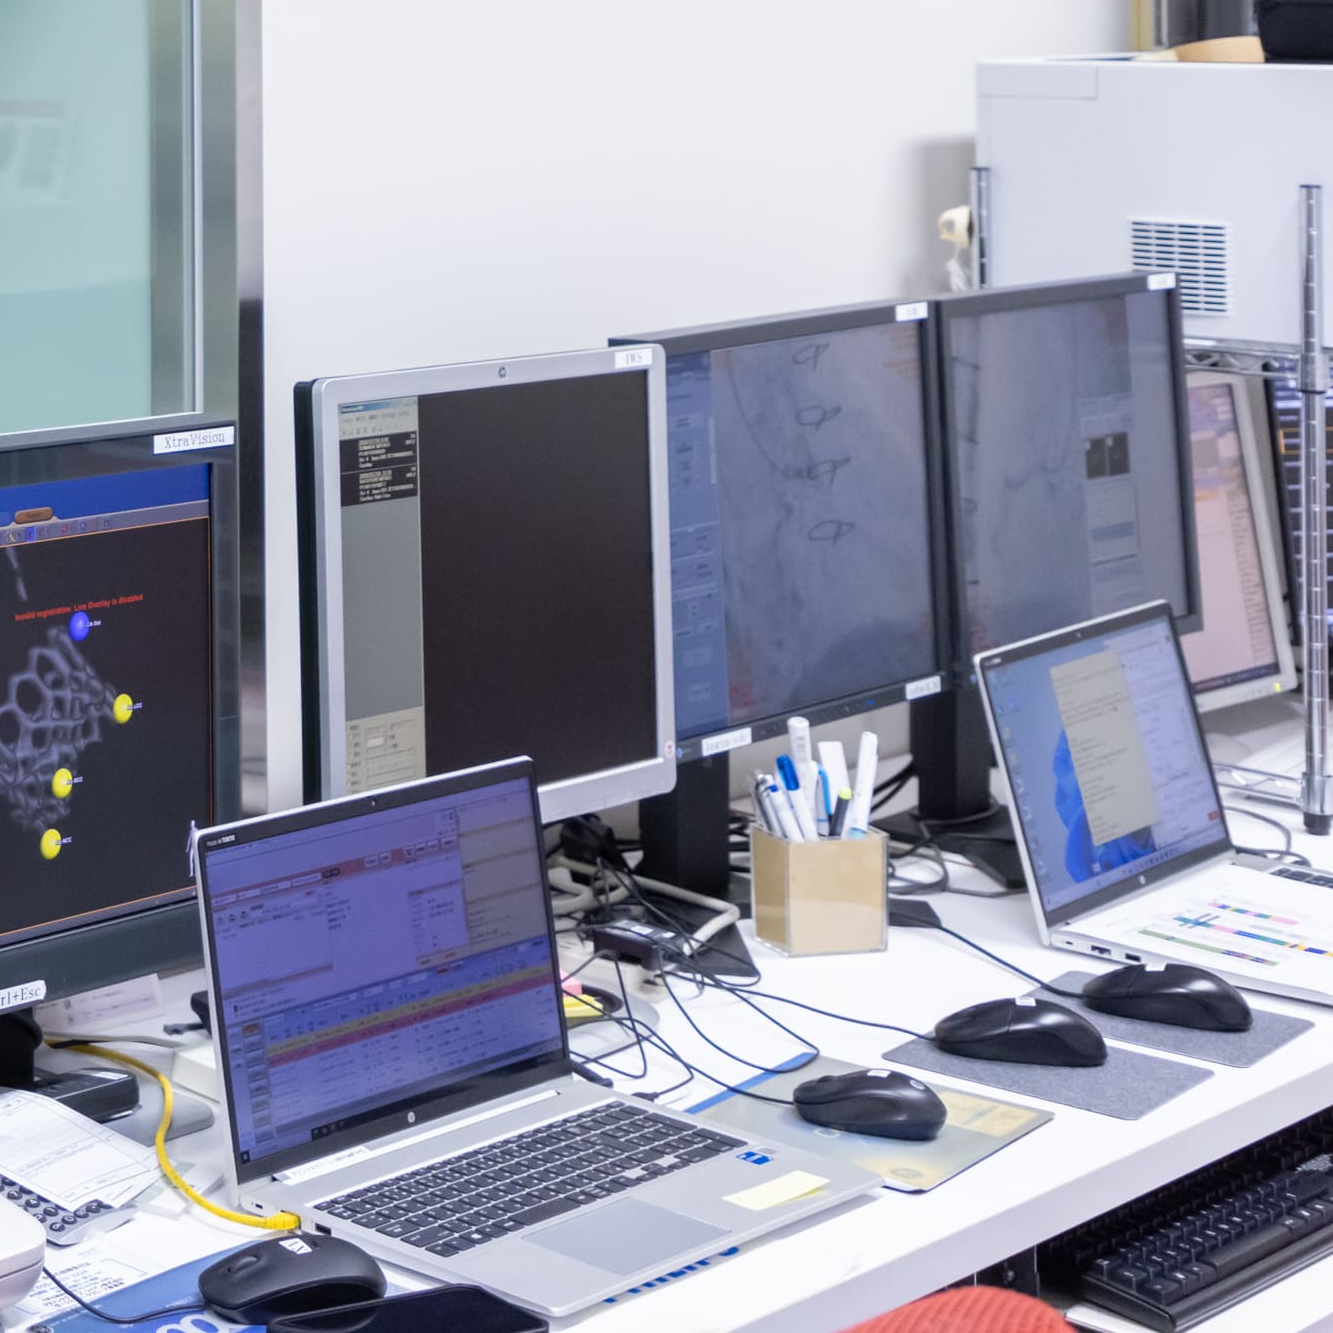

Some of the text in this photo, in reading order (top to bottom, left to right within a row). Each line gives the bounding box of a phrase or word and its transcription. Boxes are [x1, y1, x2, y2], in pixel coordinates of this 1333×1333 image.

[15, 611, 36, 621] Invalid
[88, 600, 110, 610] Overlay
[118, 594, 144, 604] disabled
